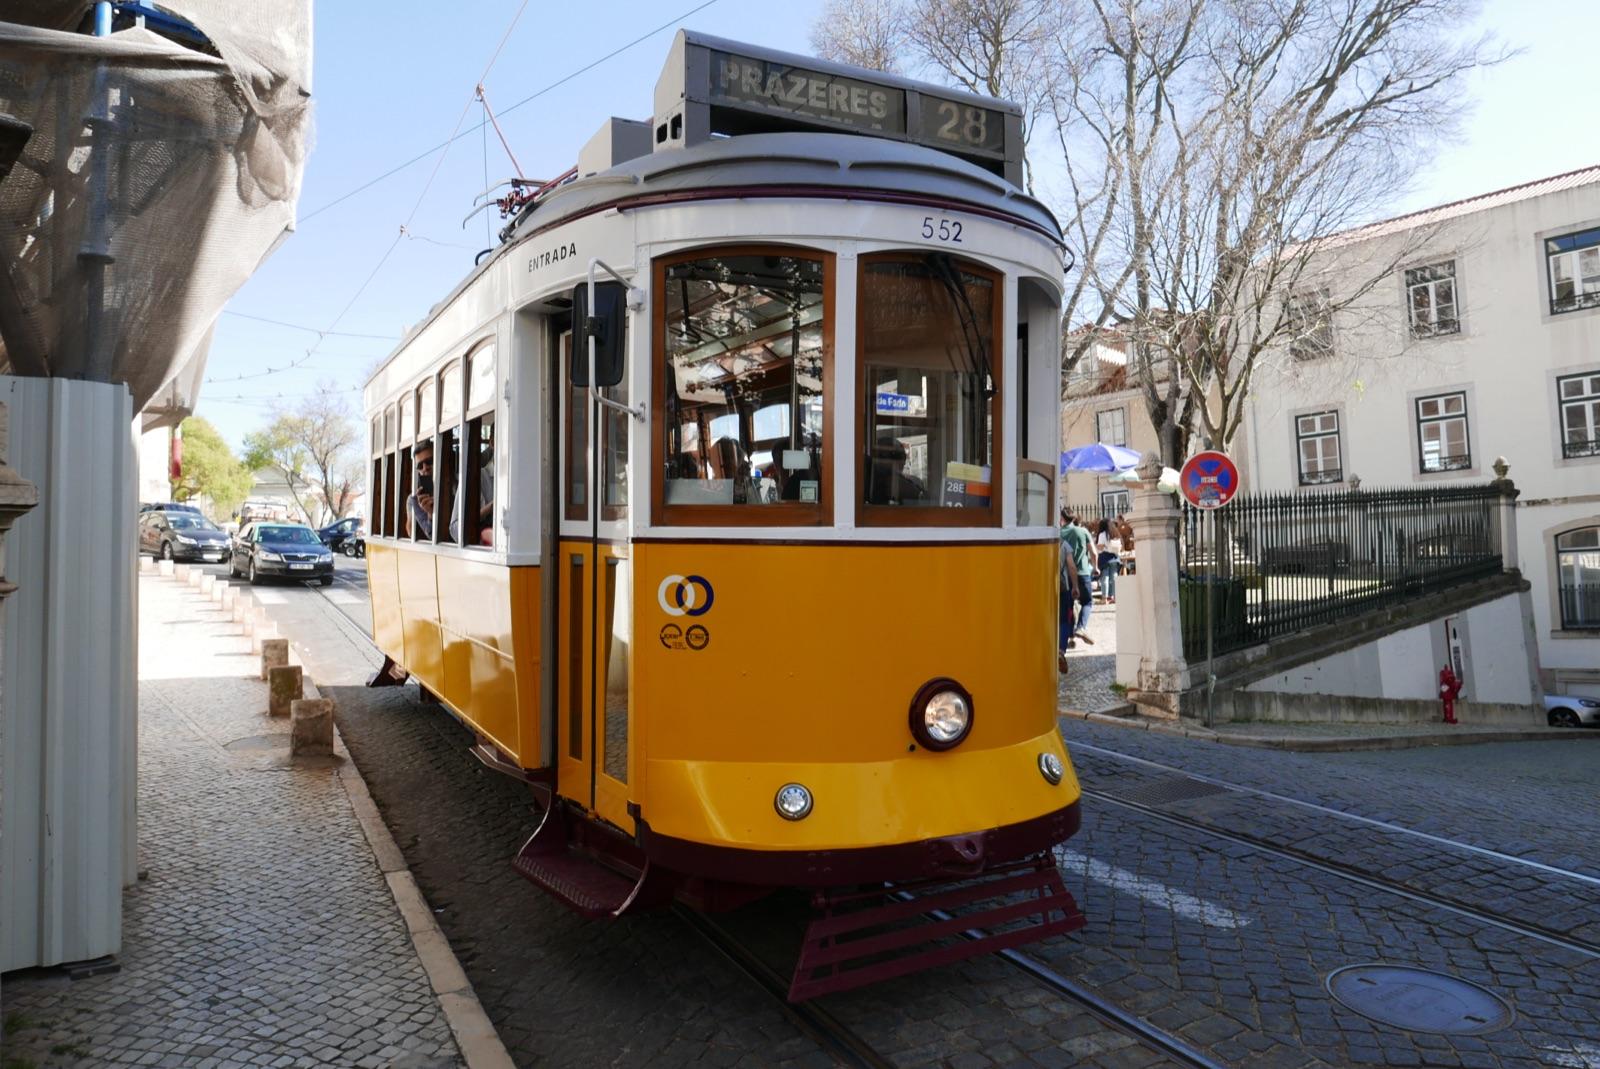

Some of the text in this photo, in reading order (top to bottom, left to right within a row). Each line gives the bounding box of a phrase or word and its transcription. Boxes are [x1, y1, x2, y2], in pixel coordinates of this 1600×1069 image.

[721, 61, 888, 119] PRAZERES
[936, 102, 987, 144] 28
[922, 217, 962, 242] 552
[529, 243, 576, 272] ENTRADA
[946, 481, 965, 494] 28E
